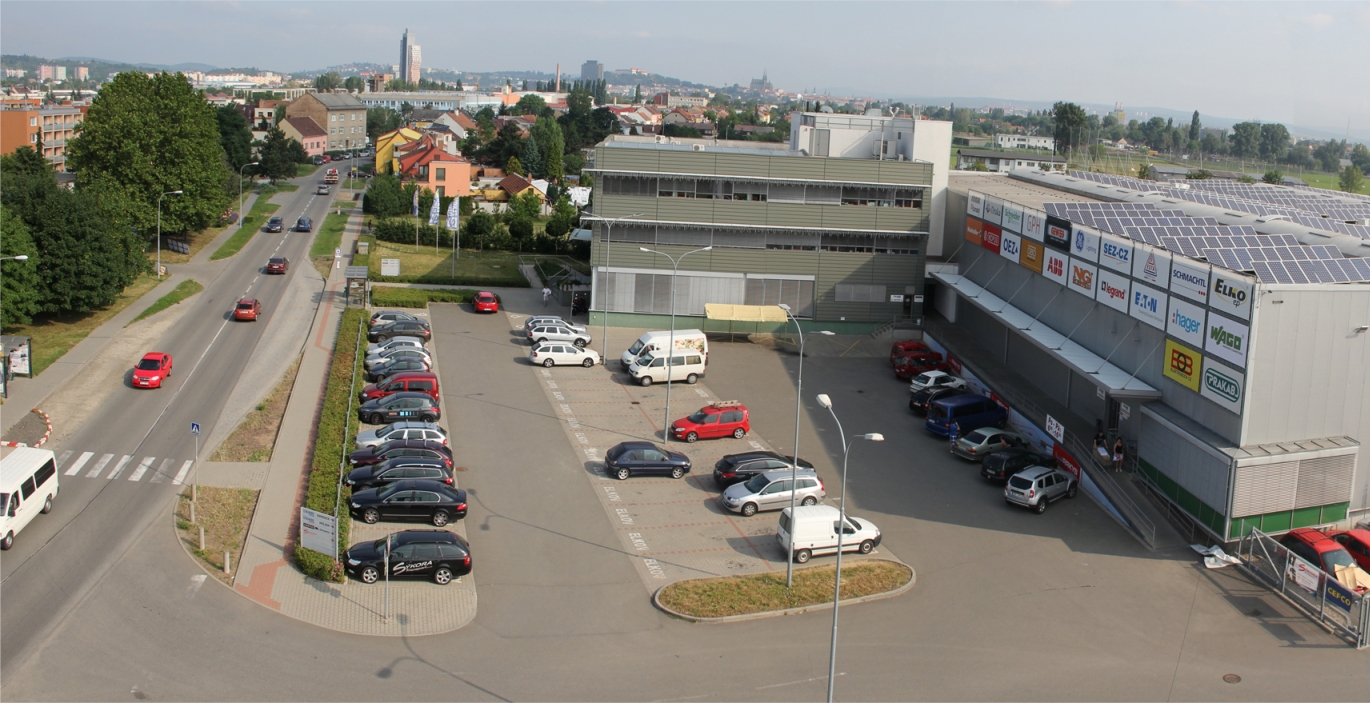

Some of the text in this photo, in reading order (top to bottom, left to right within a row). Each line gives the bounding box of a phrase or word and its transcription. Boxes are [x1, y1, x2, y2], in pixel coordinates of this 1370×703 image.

[1003, 238, 1015, 255] OEZ
[1047, 256, 1063, 277] ABB
[1172, 269, 1206, 288] SCHMACHTL
[1214, 277, 1246, 302] ELKO
[1210, 325, 1241, 351] WAGO
